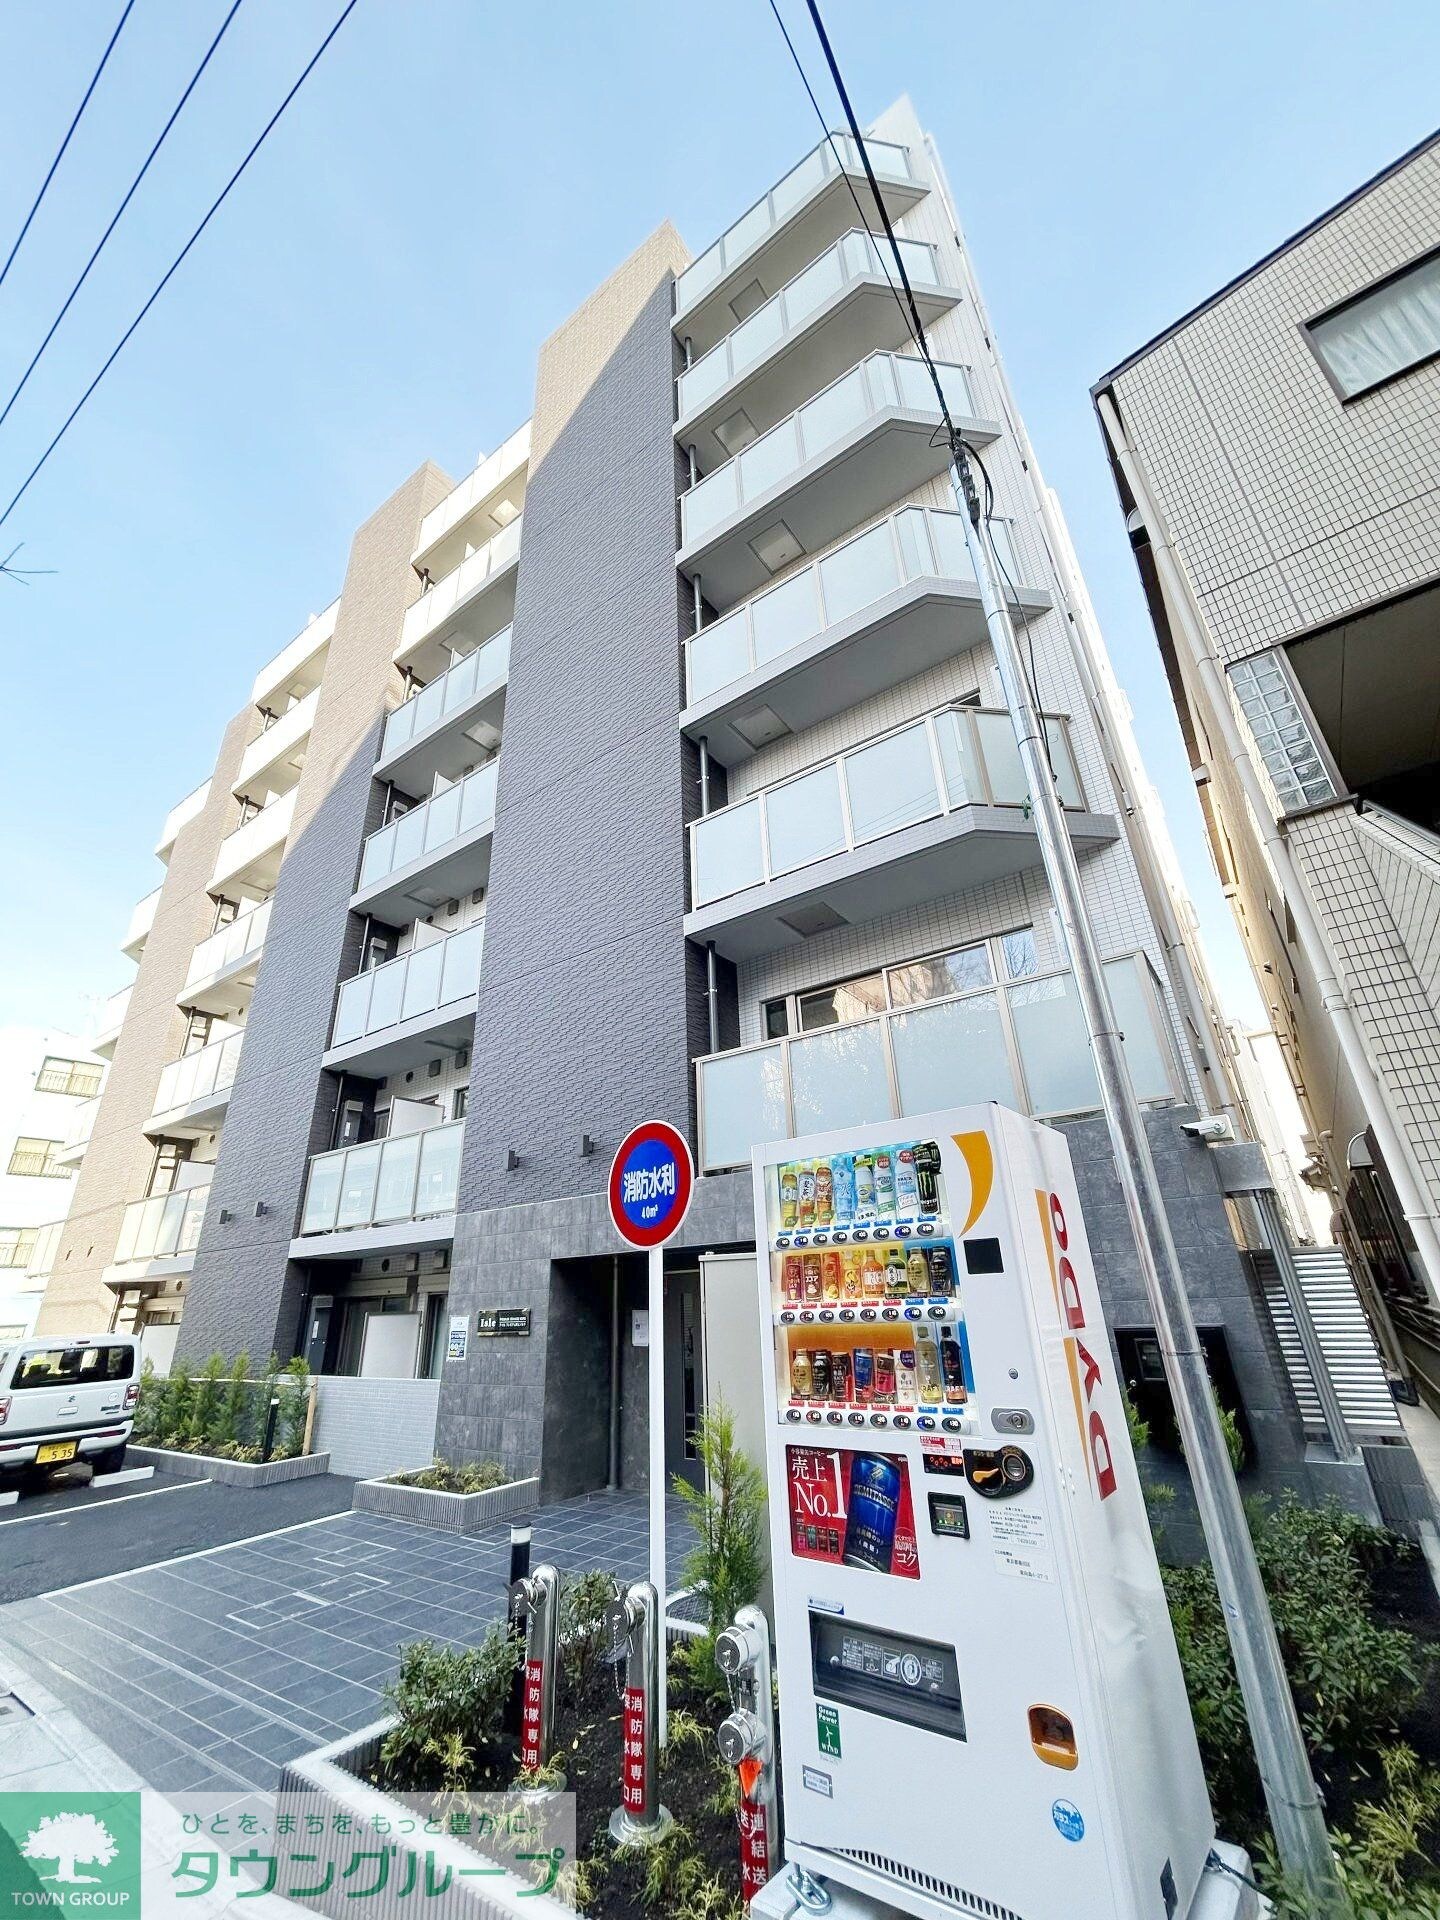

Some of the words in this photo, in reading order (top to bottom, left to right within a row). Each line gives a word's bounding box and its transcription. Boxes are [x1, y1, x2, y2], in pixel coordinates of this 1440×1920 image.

[623, 1161, 675, 1203] 消防水利
[480, 1318, 496, 1328] Isle
[792, 1456, 827, 1482] 売上
[528, 1667, 541, 1765] 消防隊専用
[631, 1696, 643, 1805] 消防隊専用
